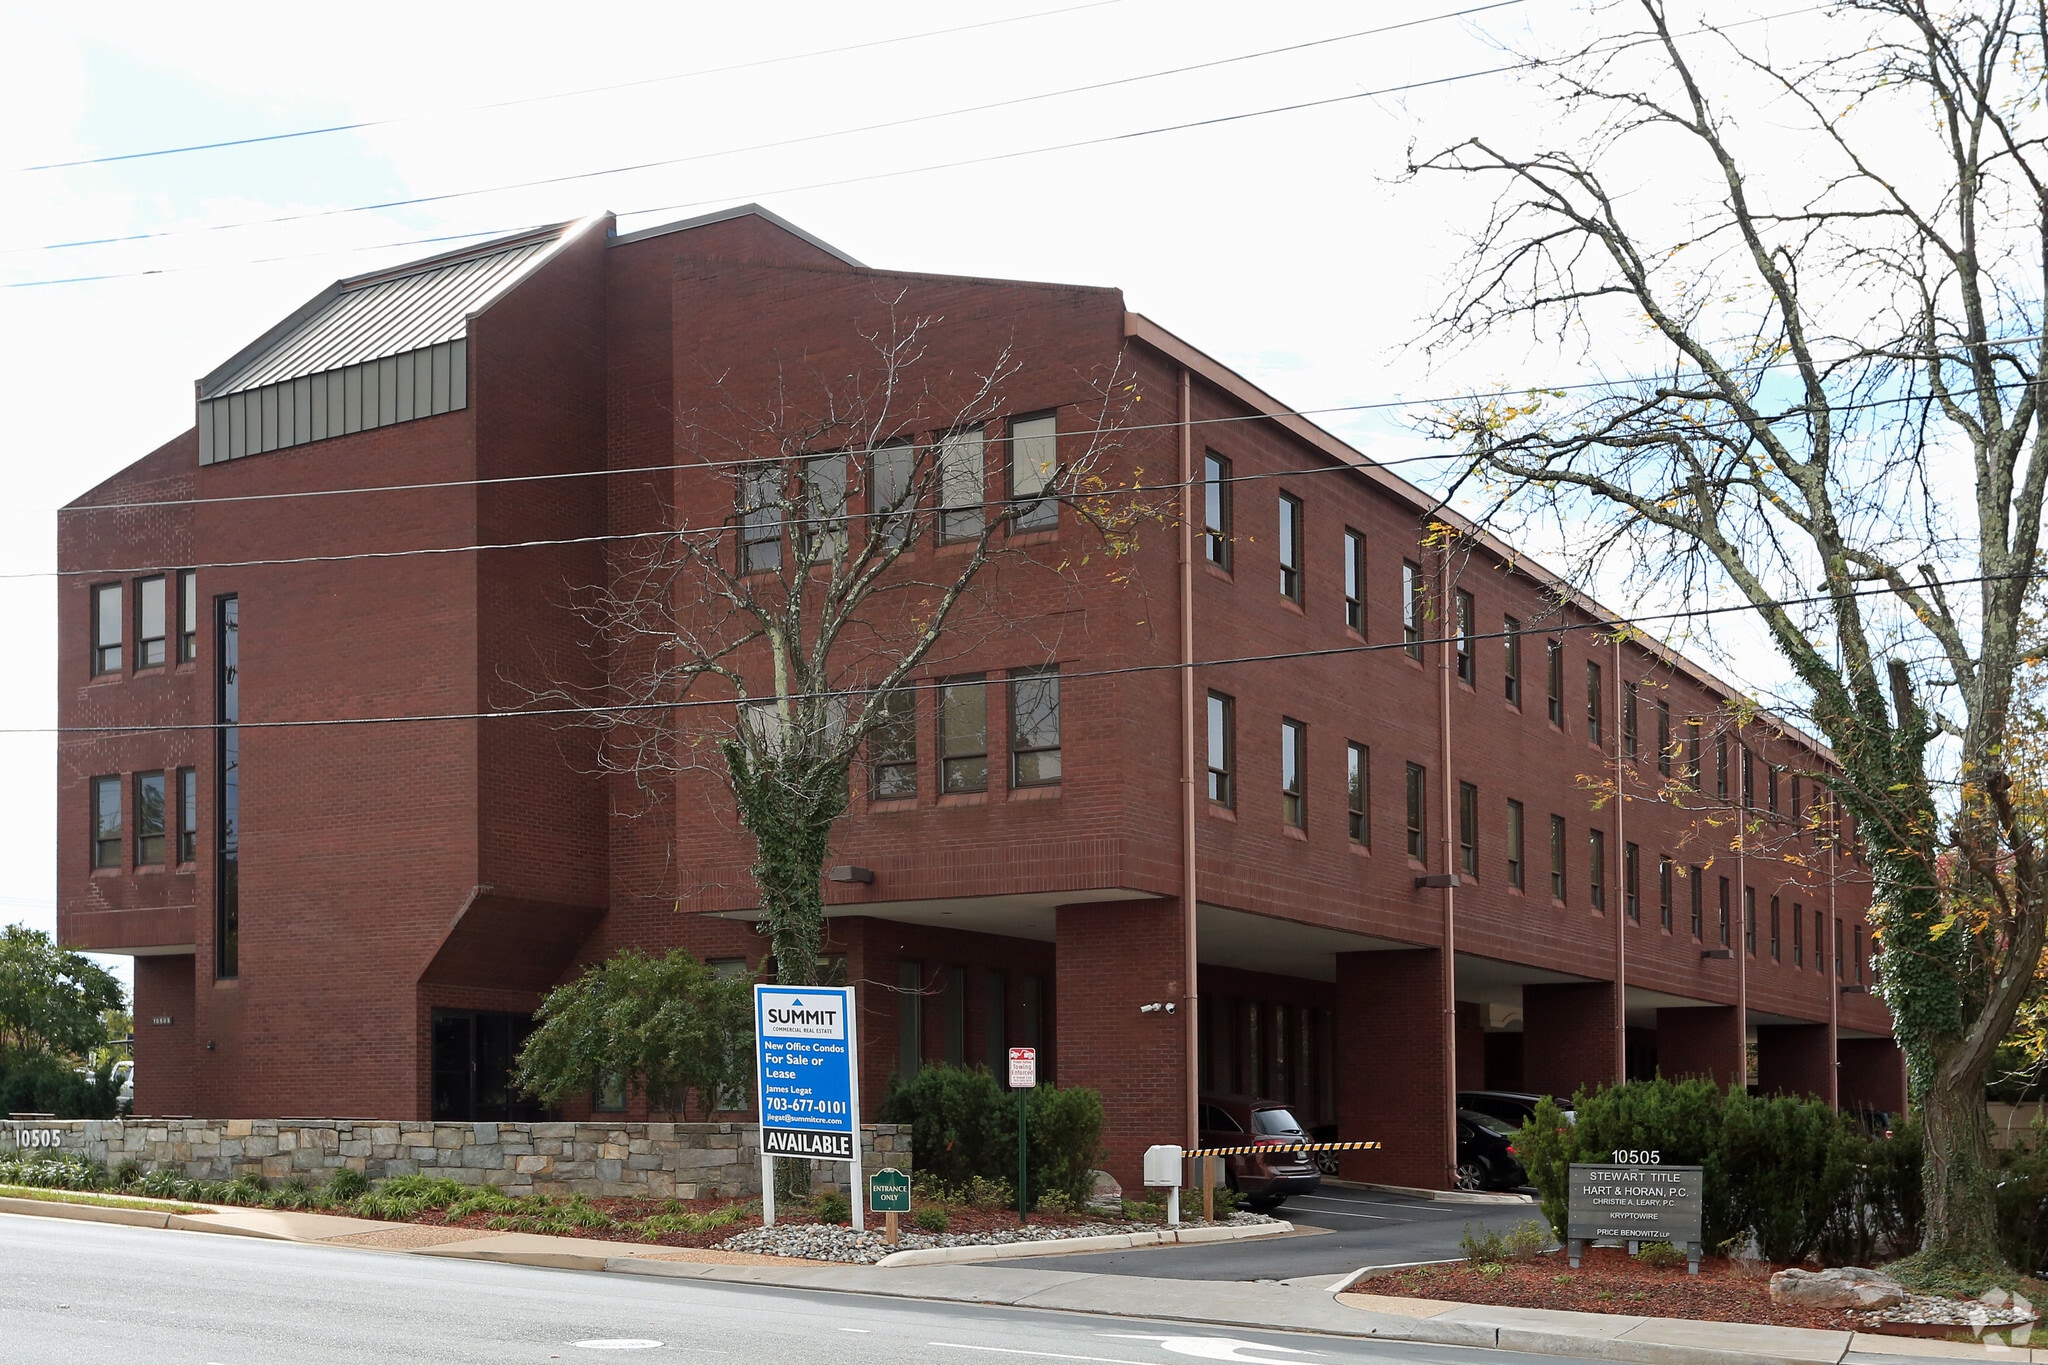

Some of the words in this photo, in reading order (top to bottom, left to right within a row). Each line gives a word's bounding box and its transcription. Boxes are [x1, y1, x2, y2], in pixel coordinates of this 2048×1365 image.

[767, 1008, 837, 1026] SUMMIT
[764, 1041, 784, 1051] New
[785, 1042, 811, 1052] Office
[812, 1043, 845, 1053] Condos
[765, 1053, 784, 1064] For
[786, 1053, 809, 1065] Sale
[811, 1058, 824, 1066] or
[765, 1067, 796, 1079] Lease
[766, 1084, 789, 1094] James
[790, 1085, 813, 1096] Legat
[766, 1097, 847, 1115] 703-677-0101
[766, 1113, 843, 1125] jlegat@summitcre.com
[15, 1129, 61, 1148] 10505
[767, 1131, 850, 1155] AVAILABLE
[1611, 1149, 1660, 1165] 10505
[1590, 1171, 1645, 1182] STEWART
[1650, 1173, 1681, 1183] TITLE
[1583, 1185, 1612, 1196] HART
[1614, 1186, 1623, 1196] &
[1624, 1187, 1667, 1198] HORAN,
[1669, 1188, 1689, 1197] P.C.
[1592, 1198, 1627, 1206] CHRISTIE
[1636, 1199, 1661, 1207] LEARY,
[1609, 1212, 1659, 1220] KRYPTOWIRE
[1596, 1228, 1619, 1236] PRICE
[1620, 1229, 1659, 1238] BENOWITZ
